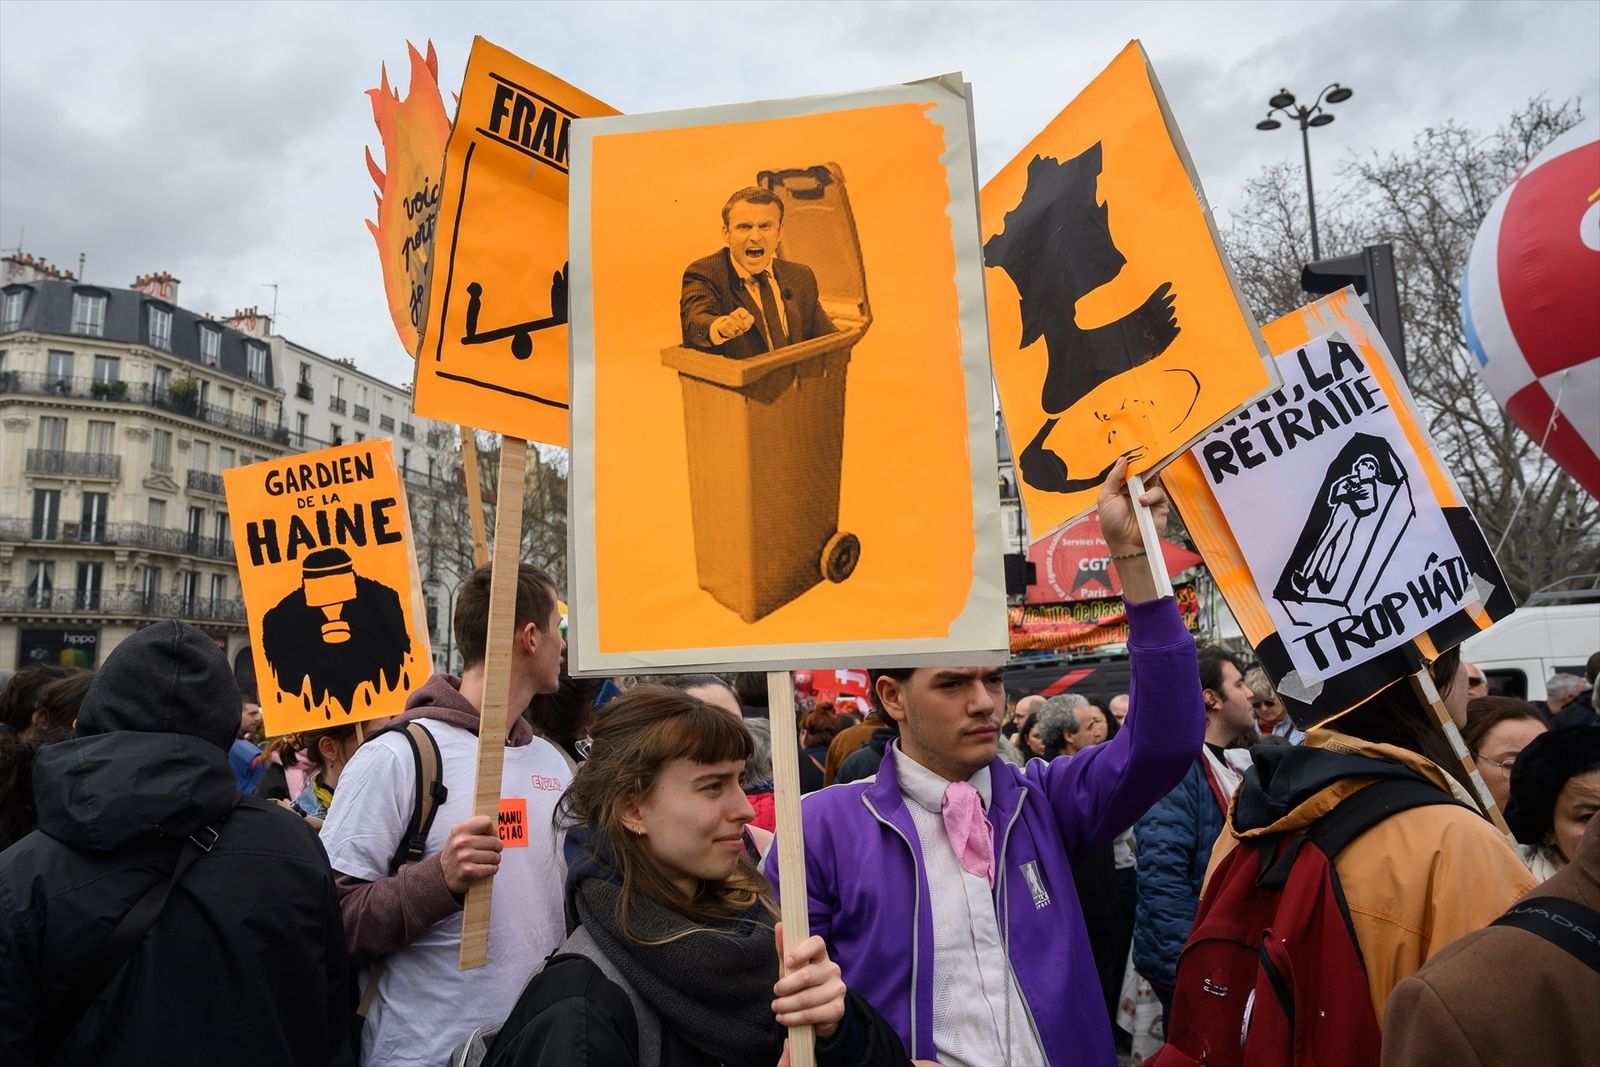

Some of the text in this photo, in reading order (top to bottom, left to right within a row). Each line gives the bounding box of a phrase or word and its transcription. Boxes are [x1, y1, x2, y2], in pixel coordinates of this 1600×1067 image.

[1203, 376, 1389, 485] RETRAITE
[265, 452, 374, 497] GARDIEN
[297, 493, 340, 509] DE LA
[246, 497, 403, 567] HAINE
[1078, 557, 1112, 572] CGT
[1080, 588, 1107, 598] Paris
[63, 631, 97, 645] hippo
[1292, 592, 1409, 672] TROP
[498, 811, 522, 826] MANU
[498, 825, 523, 840] CIAO
